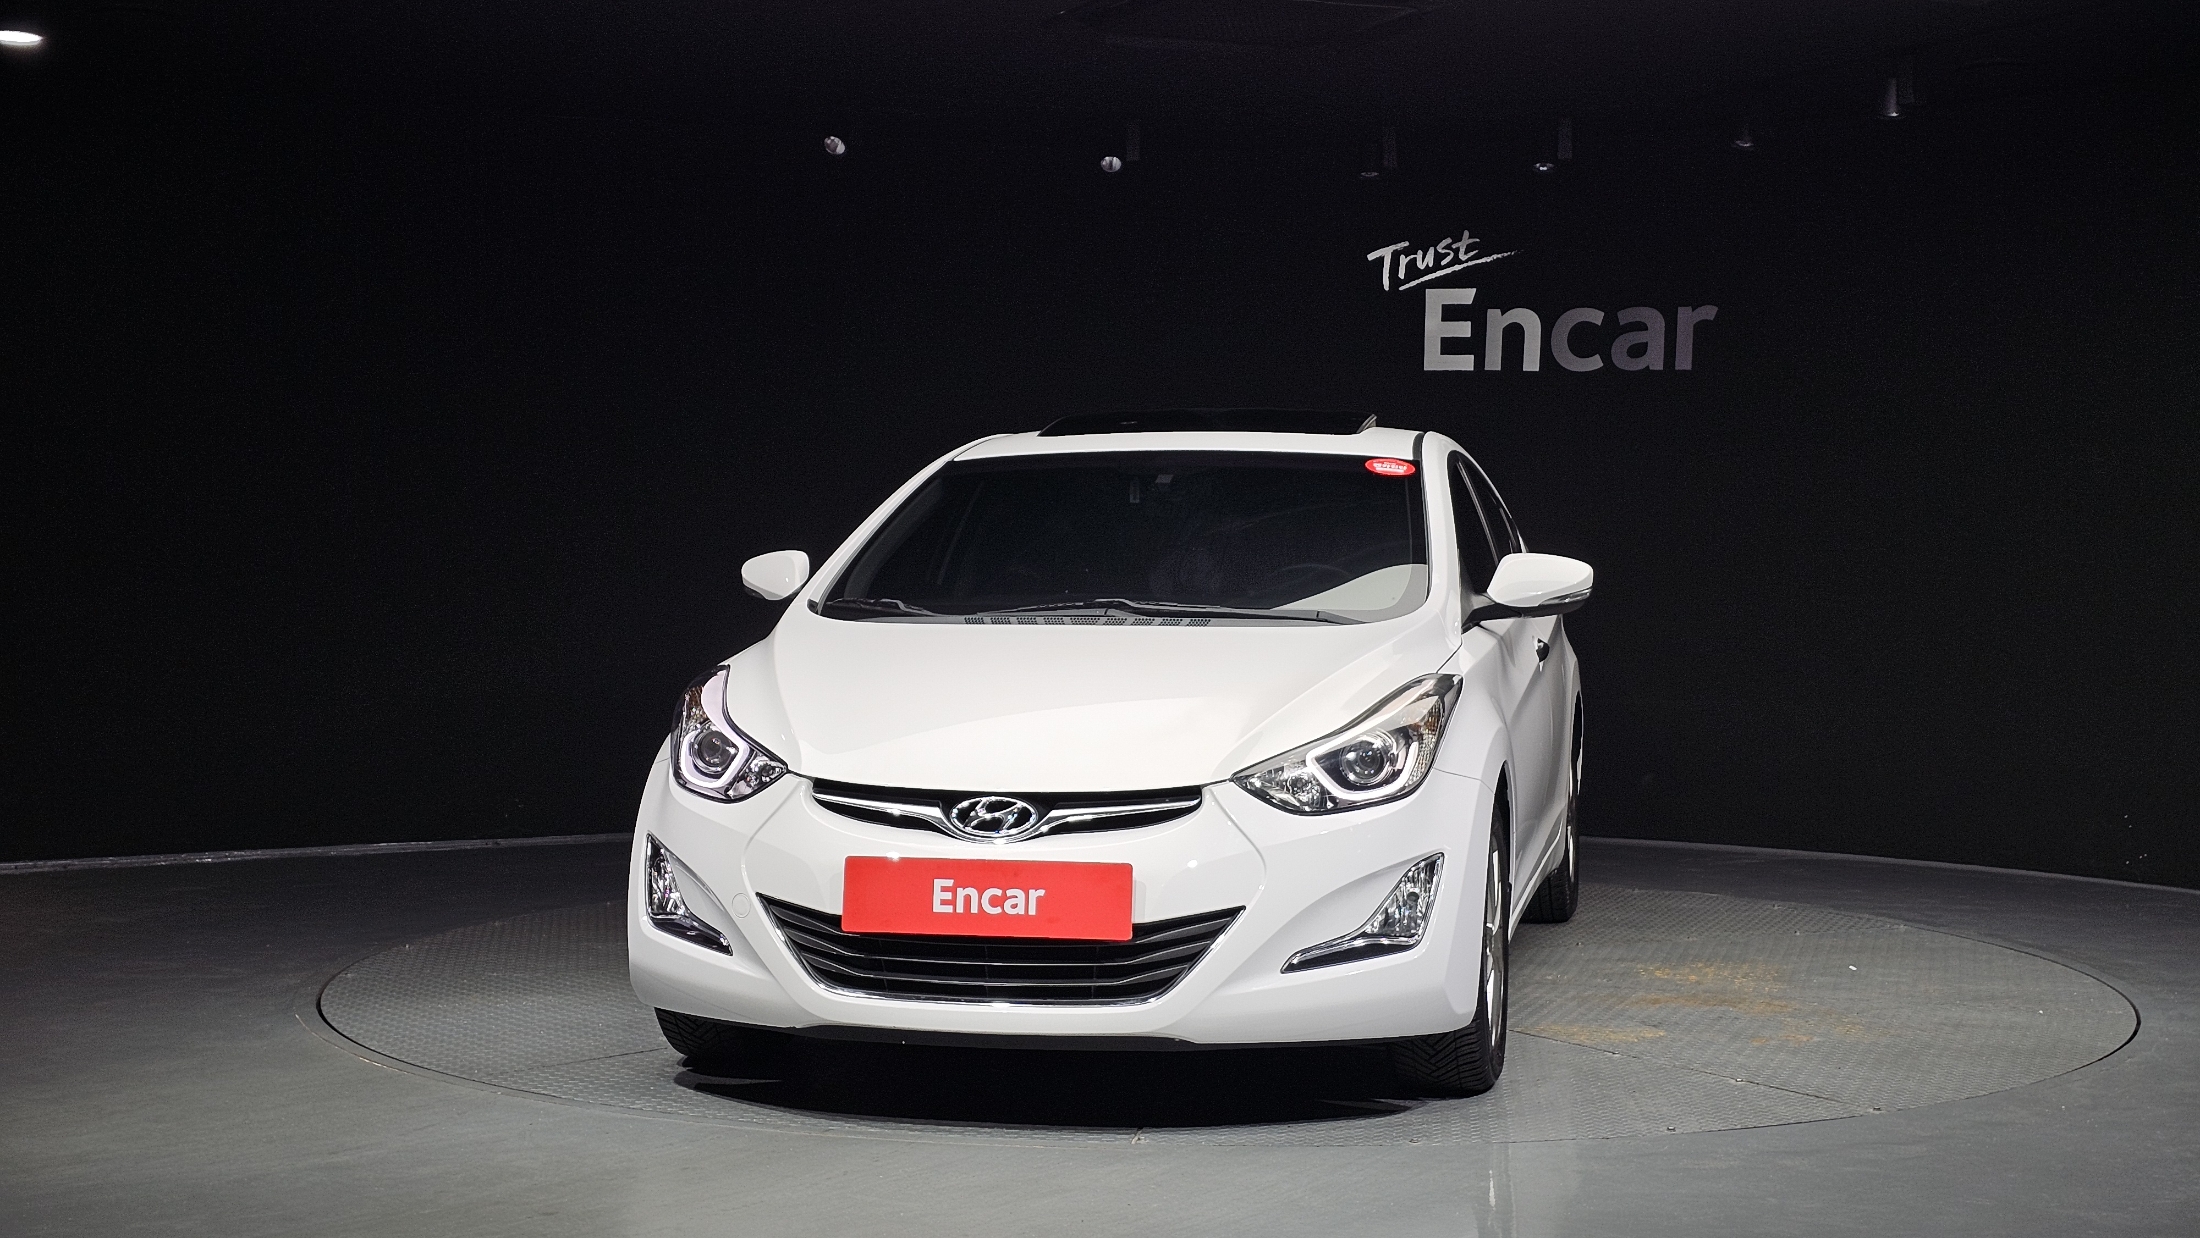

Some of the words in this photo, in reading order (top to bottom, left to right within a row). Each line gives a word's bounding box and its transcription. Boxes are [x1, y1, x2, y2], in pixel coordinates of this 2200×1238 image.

[1366, 229, 1480, 291] Trust
[1423, 287, 1719, 372] Encar
[932, 878, 1046, 916] Encar
